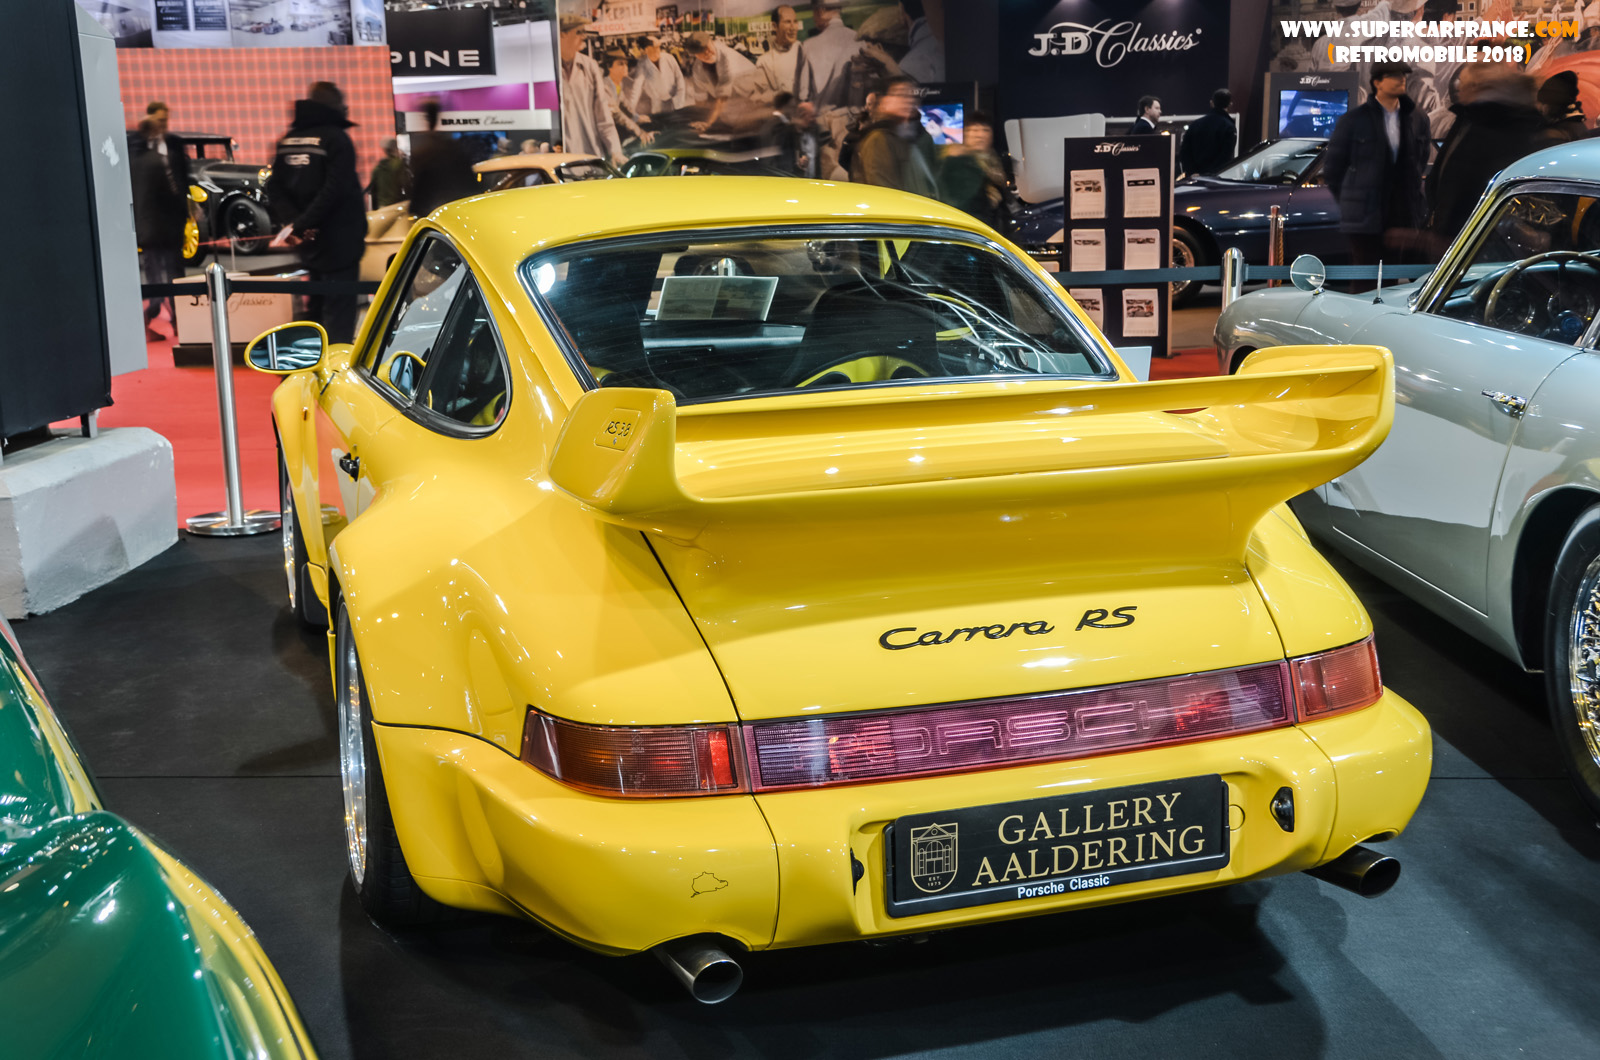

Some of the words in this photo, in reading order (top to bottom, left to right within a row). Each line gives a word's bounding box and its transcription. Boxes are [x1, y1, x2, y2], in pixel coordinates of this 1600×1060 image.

[1028, 31, 1092, 57] J.D
[1095, 18, 1200, 68] Classics
[440, 118, 481, 126] BRABUS
[878, 620, 1055, 651] Carrera
[1074, 606, 1138, 631] RS
[790, 682, 1262, 771] PORSCHE
[998, 792, 1182, 845] GALLERY
[971, 825, 1206, 886] AALDERING
[1017, 881, 1065, 899] Porsche
[1070, 874, 1111, 891] Classic
